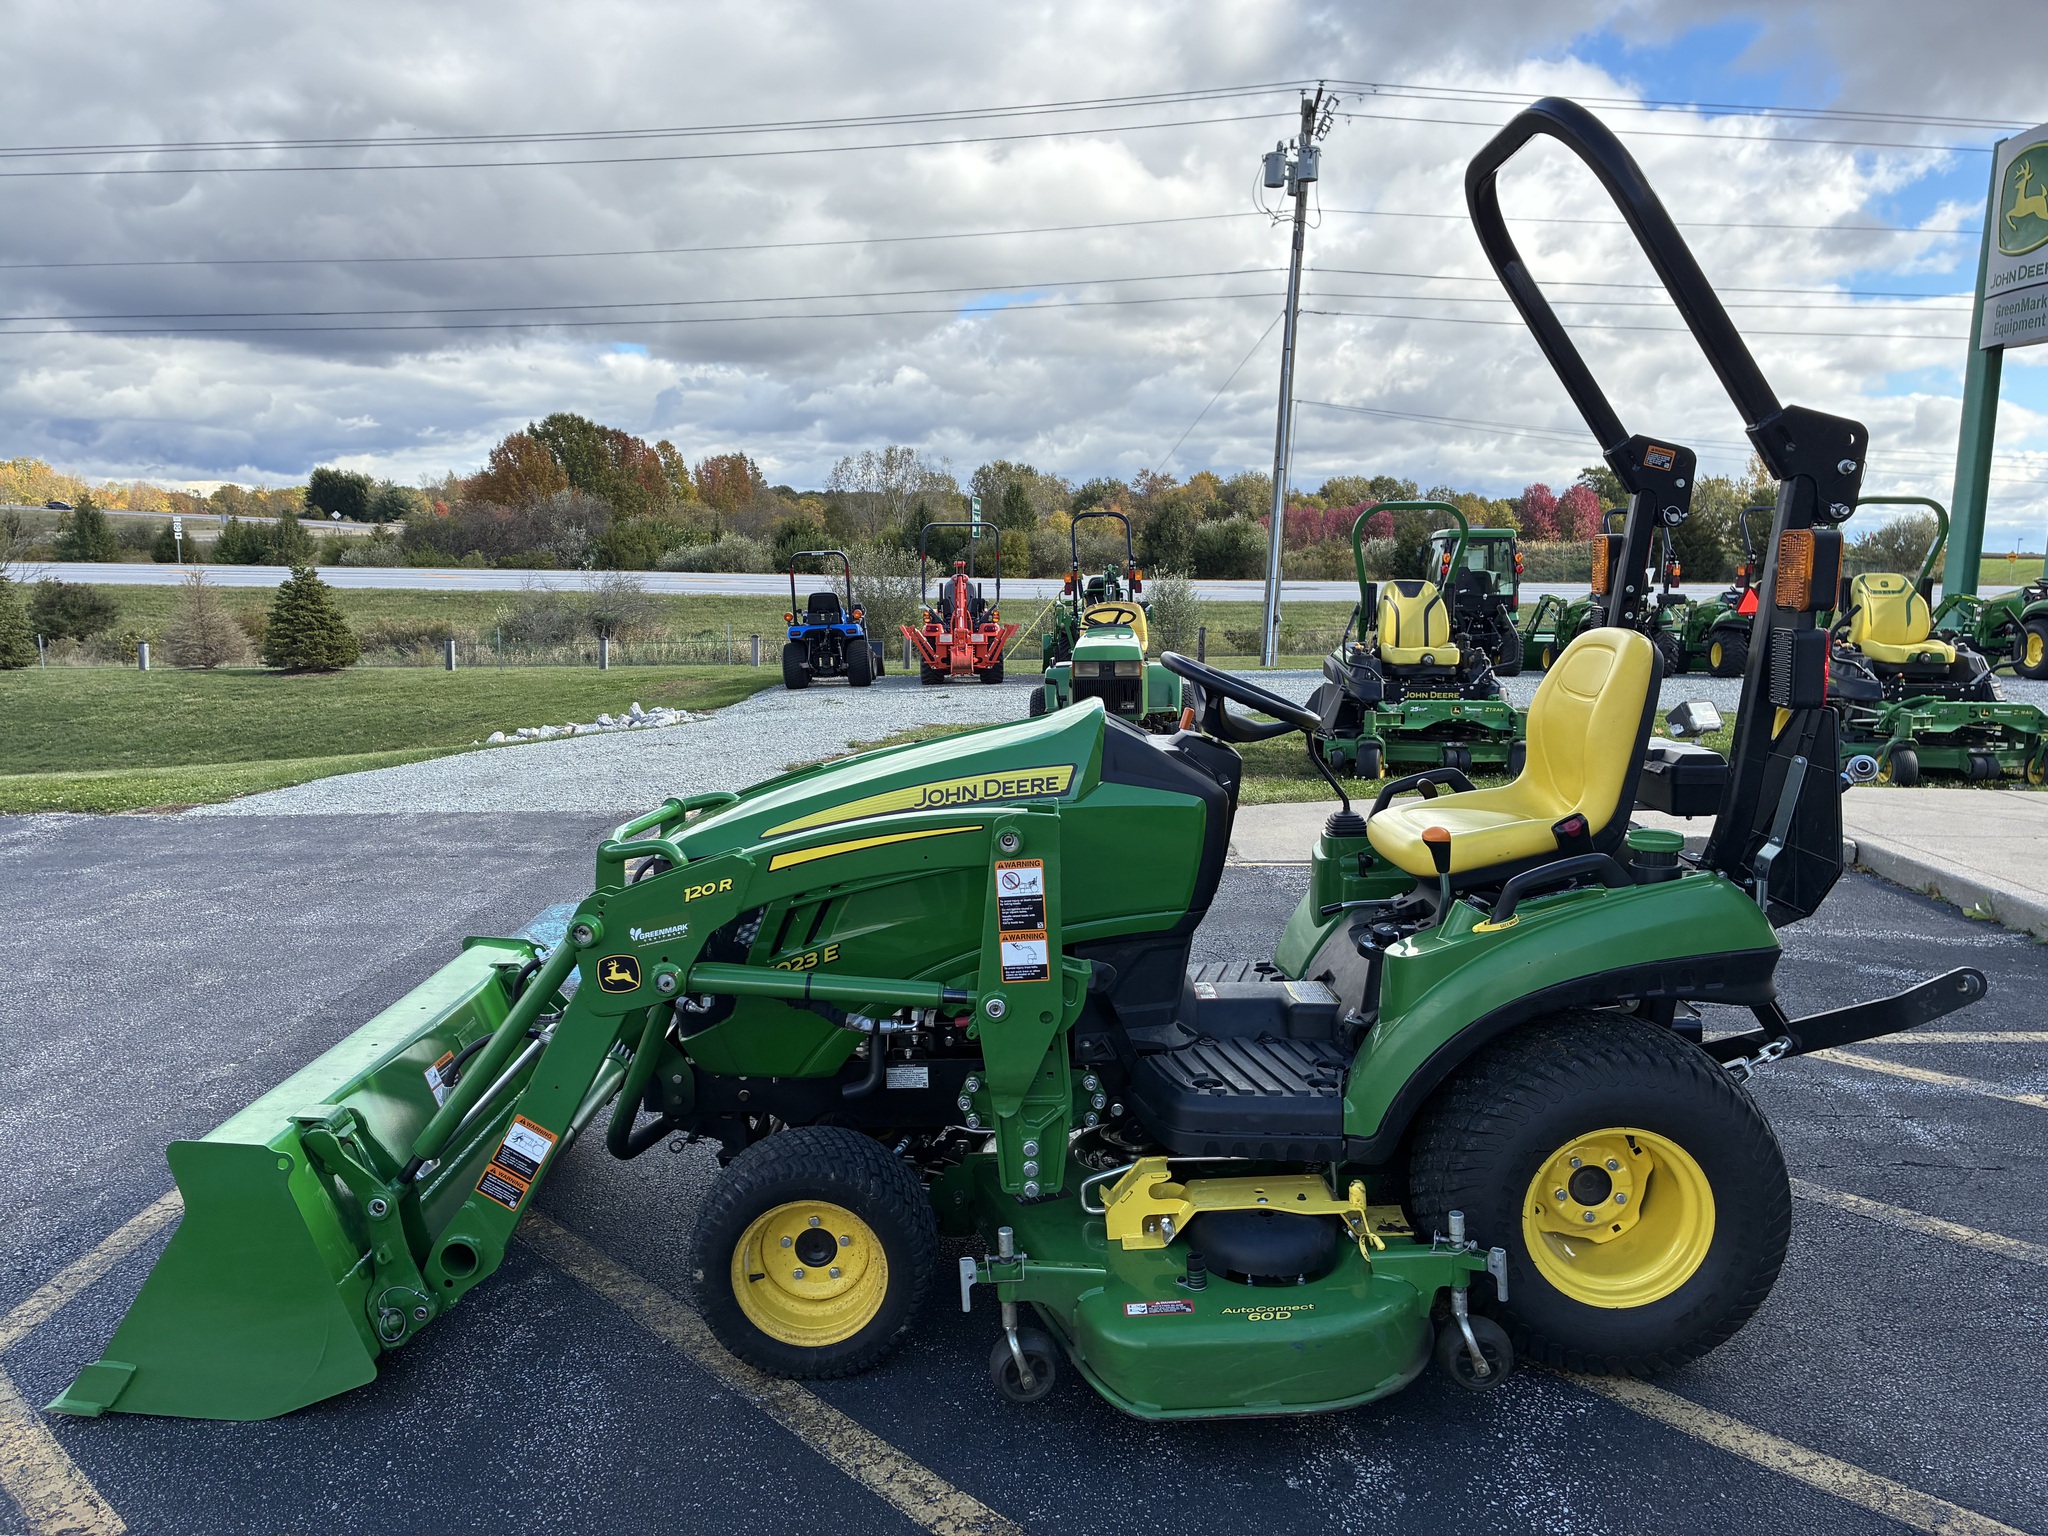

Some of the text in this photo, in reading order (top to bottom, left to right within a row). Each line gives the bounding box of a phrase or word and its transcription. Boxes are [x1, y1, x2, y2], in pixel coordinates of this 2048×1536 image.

[1990, 269, 2017, 289] JOHN
[1996, 294, 2047, 318] GreenMark
[1993, 312, 2047, 338] Equipment
[1404, 691, 1460, 699] JOHN DEERE
[914, 776, 1059, 807] JOHN DEERE
[1004, 860, 1041, 868] WARNING
[683, 878, 734, 903] 120 R
[639, 923, 688, 940] GREENMARK
[1008, 932, 1045, 941] WARNING
[769, 943, 840, 971] 023 E
[526, 1120, 553, 1140] WARNING
[497, 1170, 525, 1189] WARNING
[1221, 1303, 1315, 1315] AutoConnect
[1247, 1311, 1292, 1322] 60D
